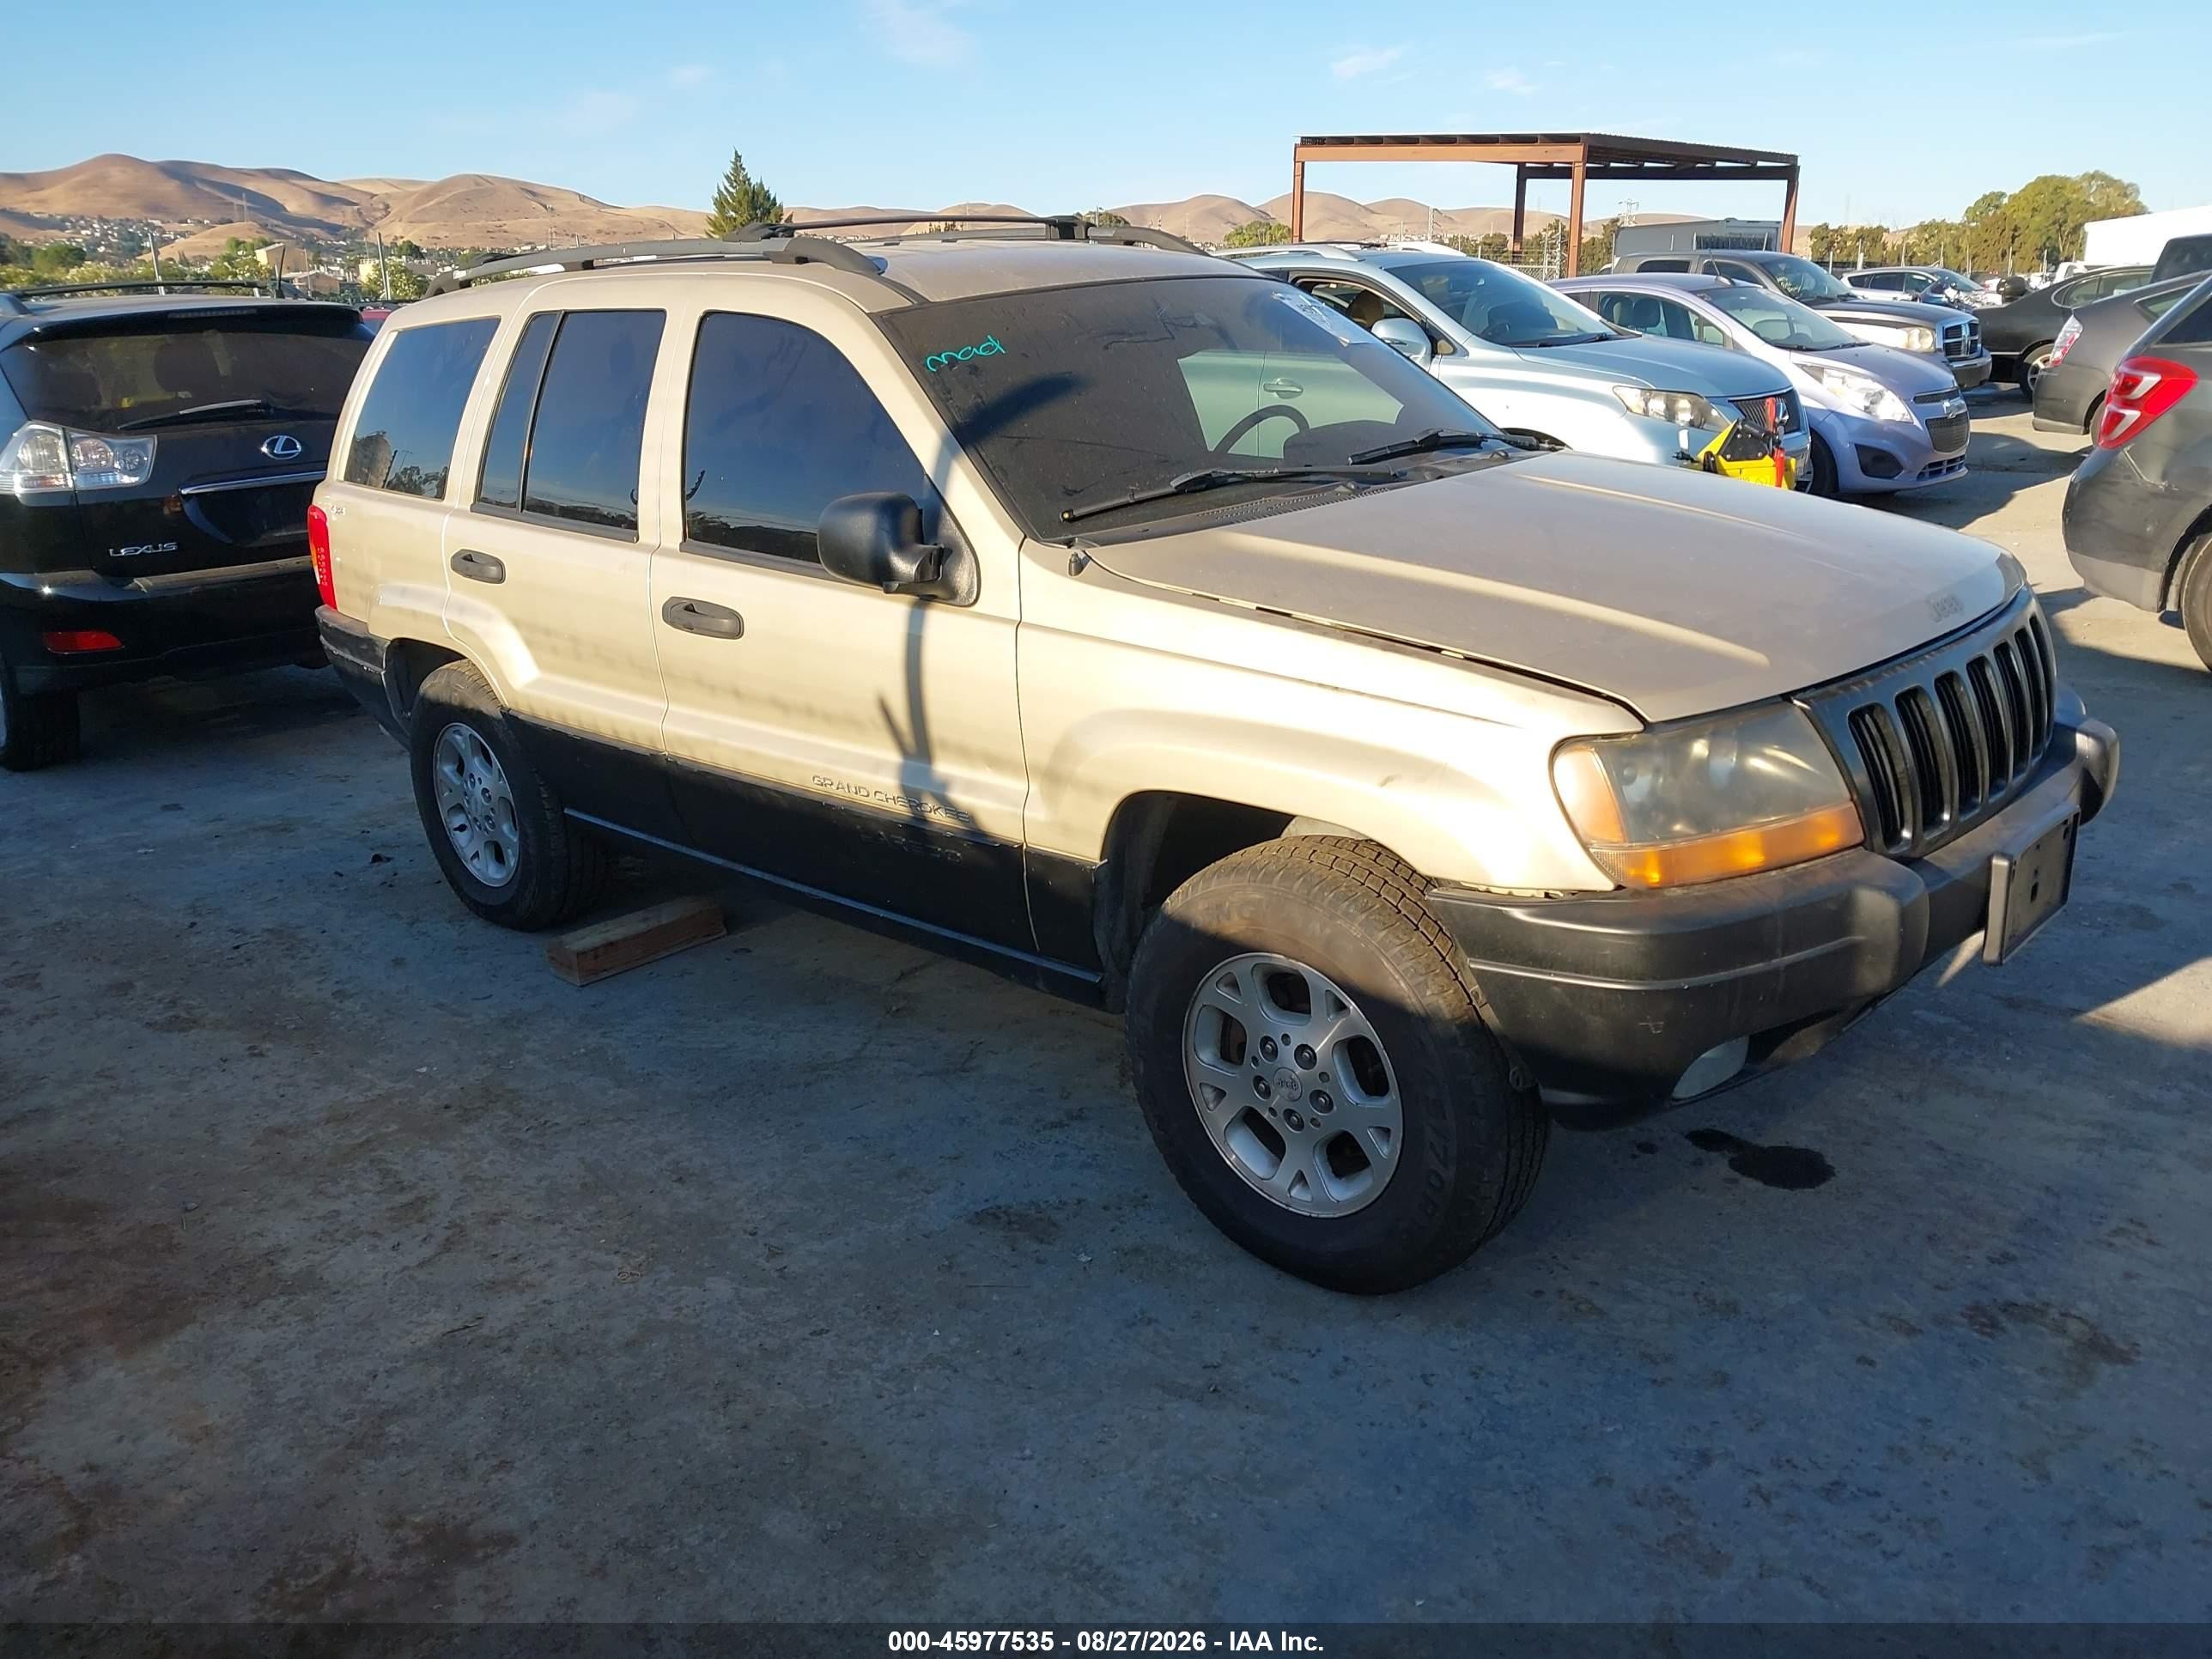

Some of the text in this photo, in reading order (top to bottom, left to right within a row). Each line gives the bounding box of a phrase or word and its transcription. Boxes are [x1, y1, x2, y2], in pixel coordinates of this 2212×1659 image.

[108, 542, 178, 556] LEXUS
[811, 775, 970, 823] GRAND CHEROKEE
